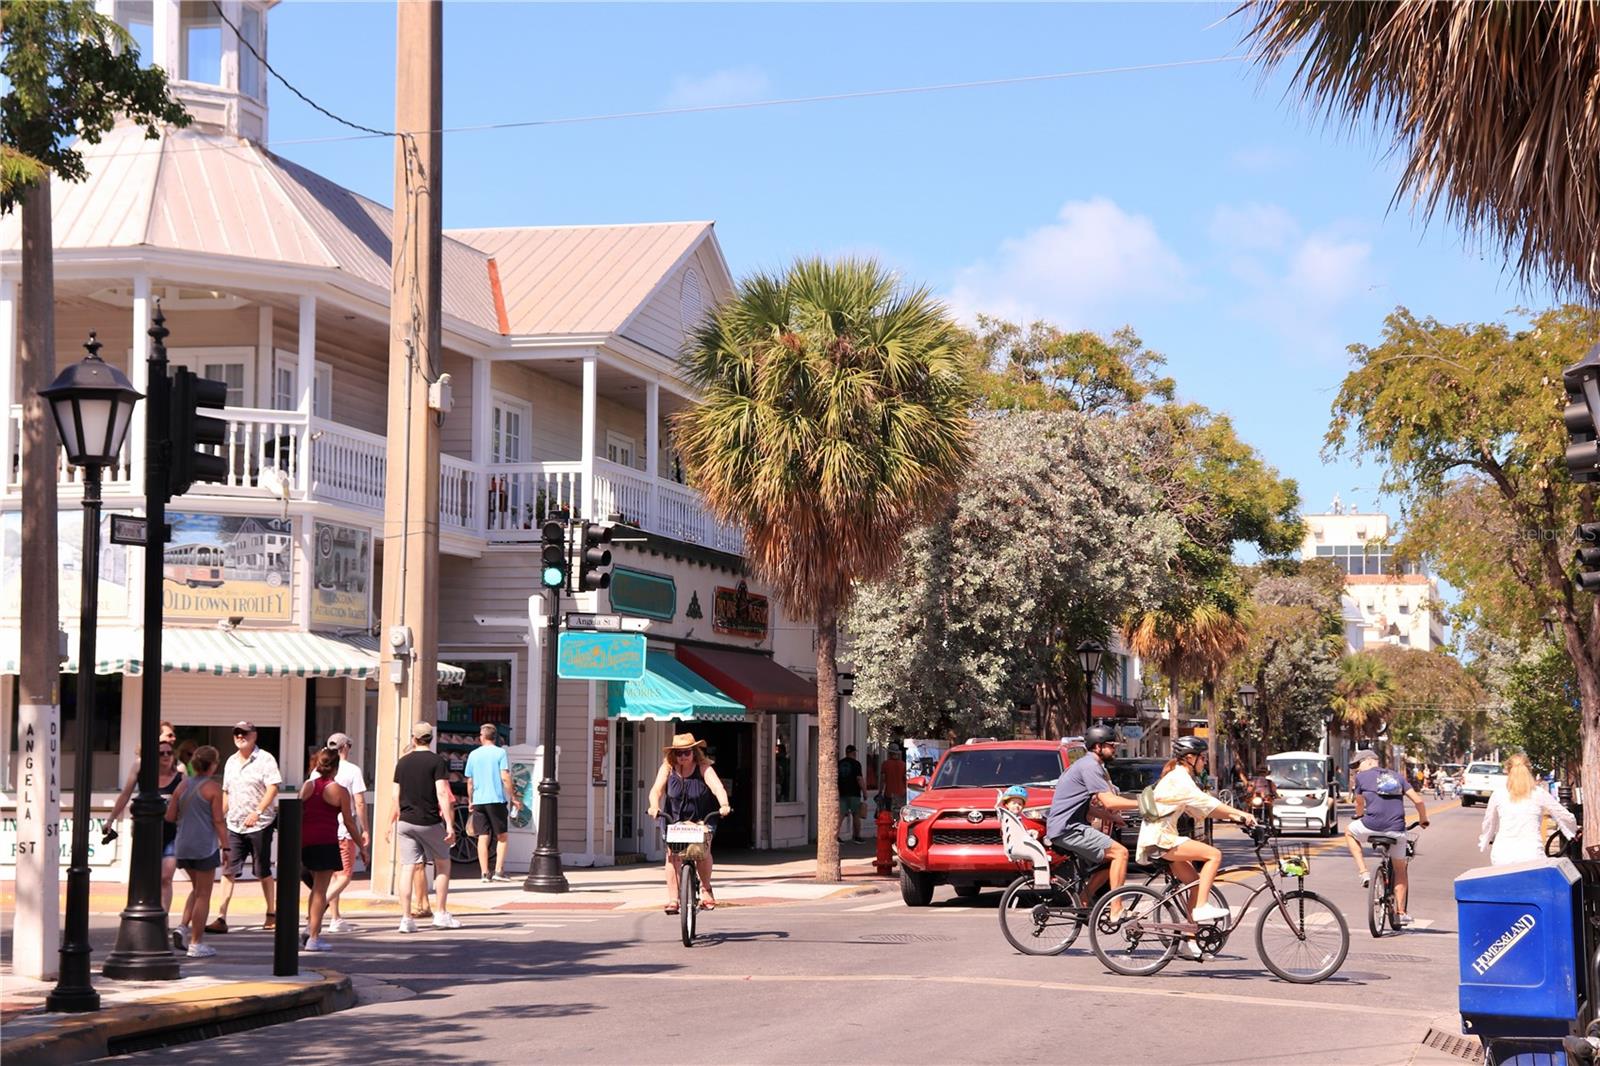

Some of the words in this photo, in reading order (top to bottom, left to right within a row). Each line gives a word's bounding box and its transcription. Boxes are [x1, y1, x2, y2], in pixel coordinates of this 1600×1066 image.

[162, 588, 191, 611] OLD
[195, 595, 230, 611] TOWN
[233, 592, 286, 614] TROLLEY
[575, 617, 600, 627] Angela
[25, 723, 34, 820] ANGELA
[47, 823, 59, 837] ST
[18, 841, 37, 855] ST
